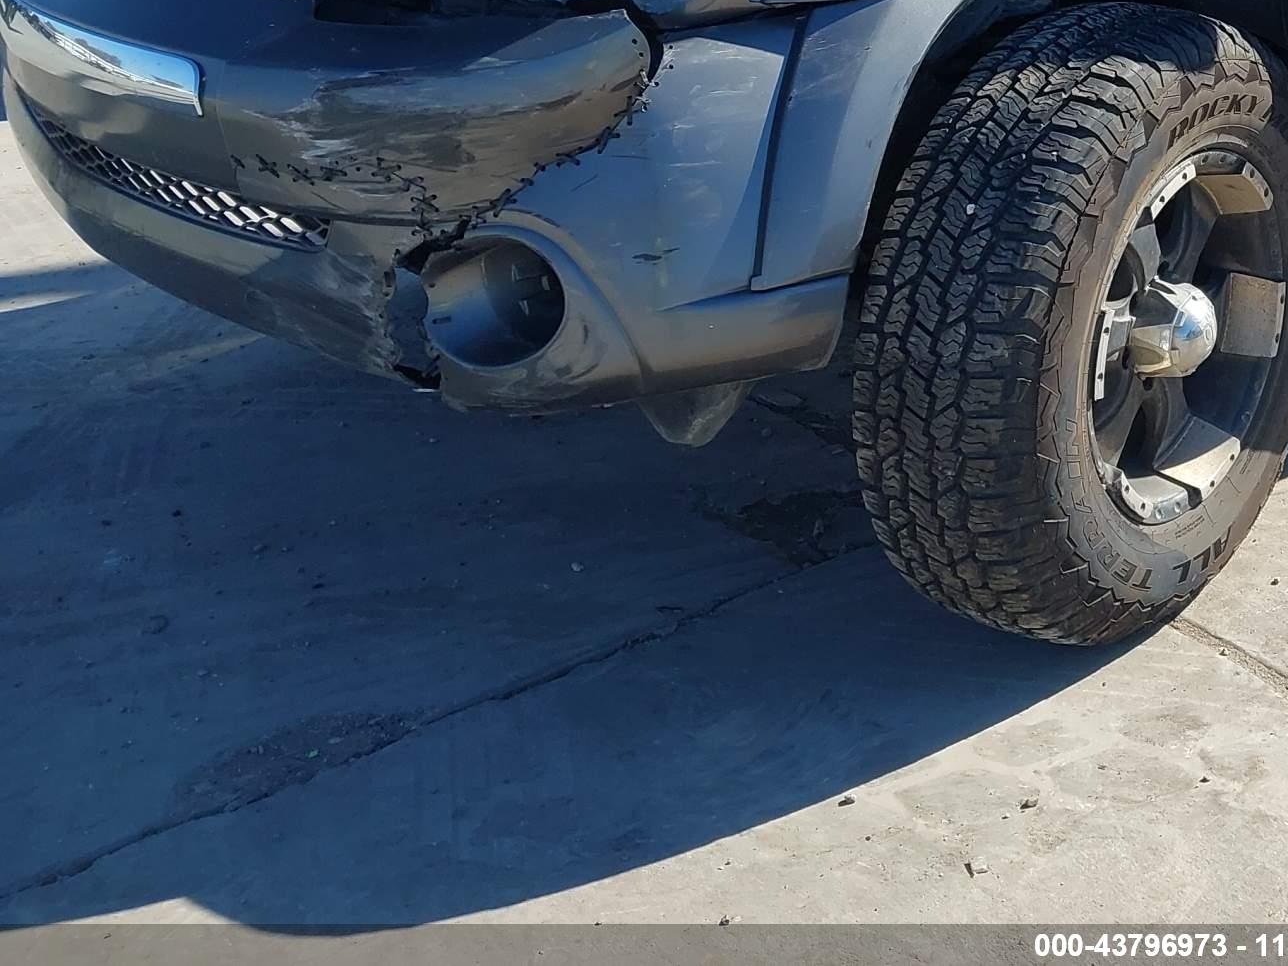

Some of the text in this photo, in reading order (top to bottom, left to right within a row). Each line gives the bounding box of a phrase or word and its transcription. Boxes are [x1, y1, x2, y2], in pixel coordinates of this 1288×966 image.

[1167, 93, 1266, 150] ROCKY
[1065, 417, 1232, 591] ALL TERRAIN
